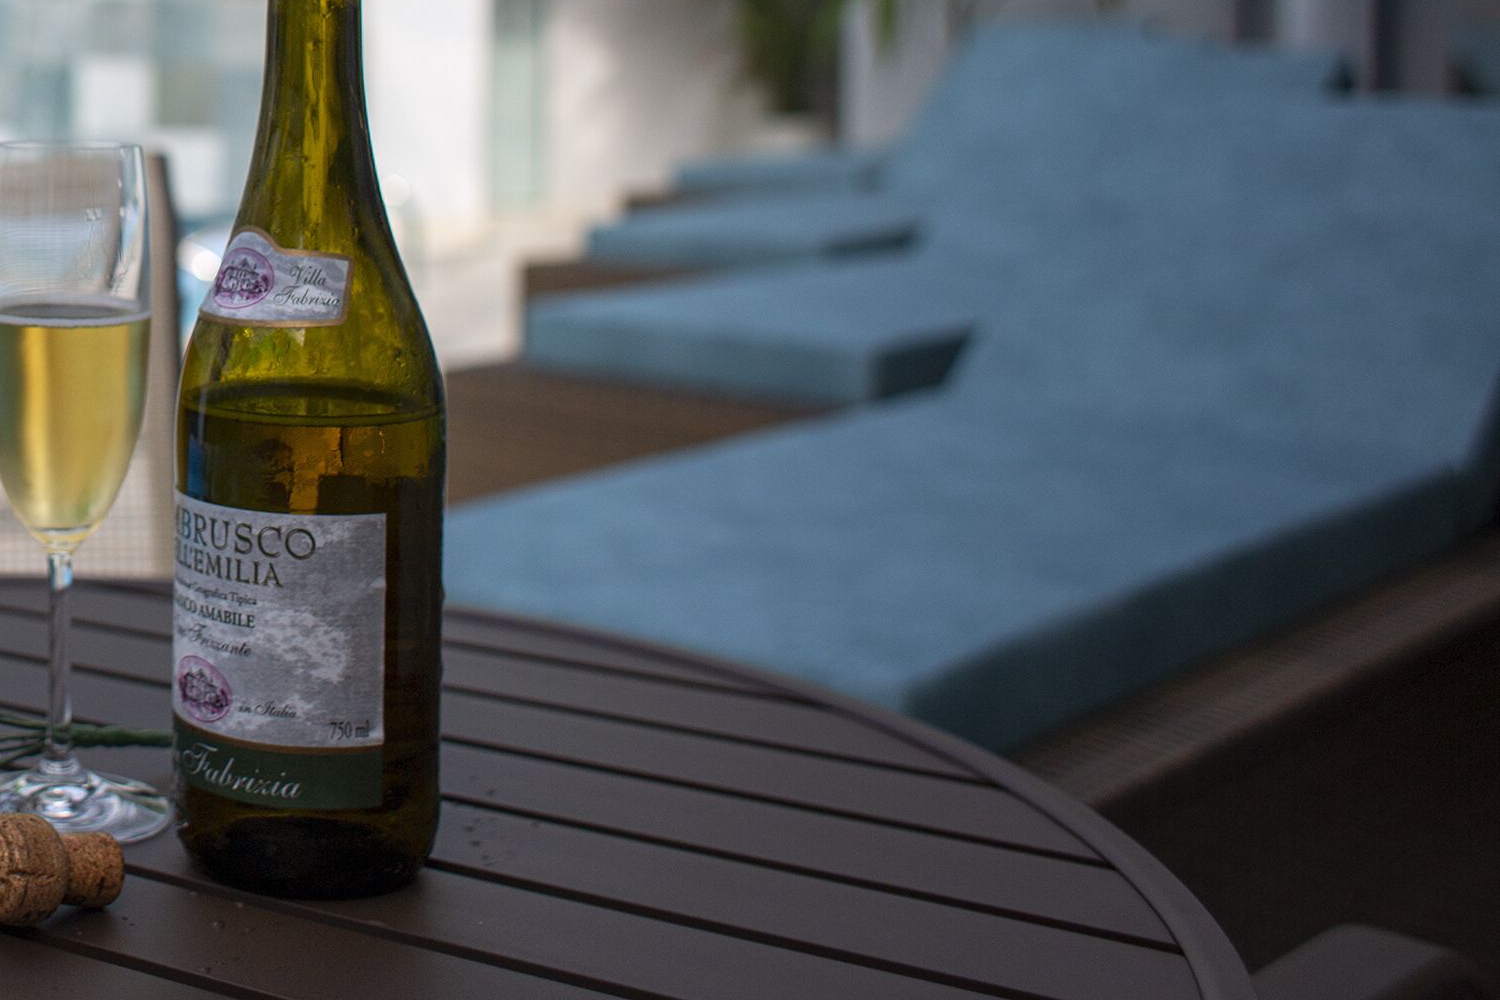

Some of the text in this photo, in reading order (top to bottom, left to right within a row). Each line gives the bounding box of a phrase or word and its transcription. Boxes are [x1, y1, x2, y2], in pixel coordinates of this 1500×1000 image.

[290, 265, 326, 286] Villa
[273, 285, 340, 306] Fabrizia
[198, 604, 256, 629] AMABILE
[255, 700, 296, 719] Italia
[330, 720, 351, 740] 750
[182, 742, 301, 798] Fabrizia
